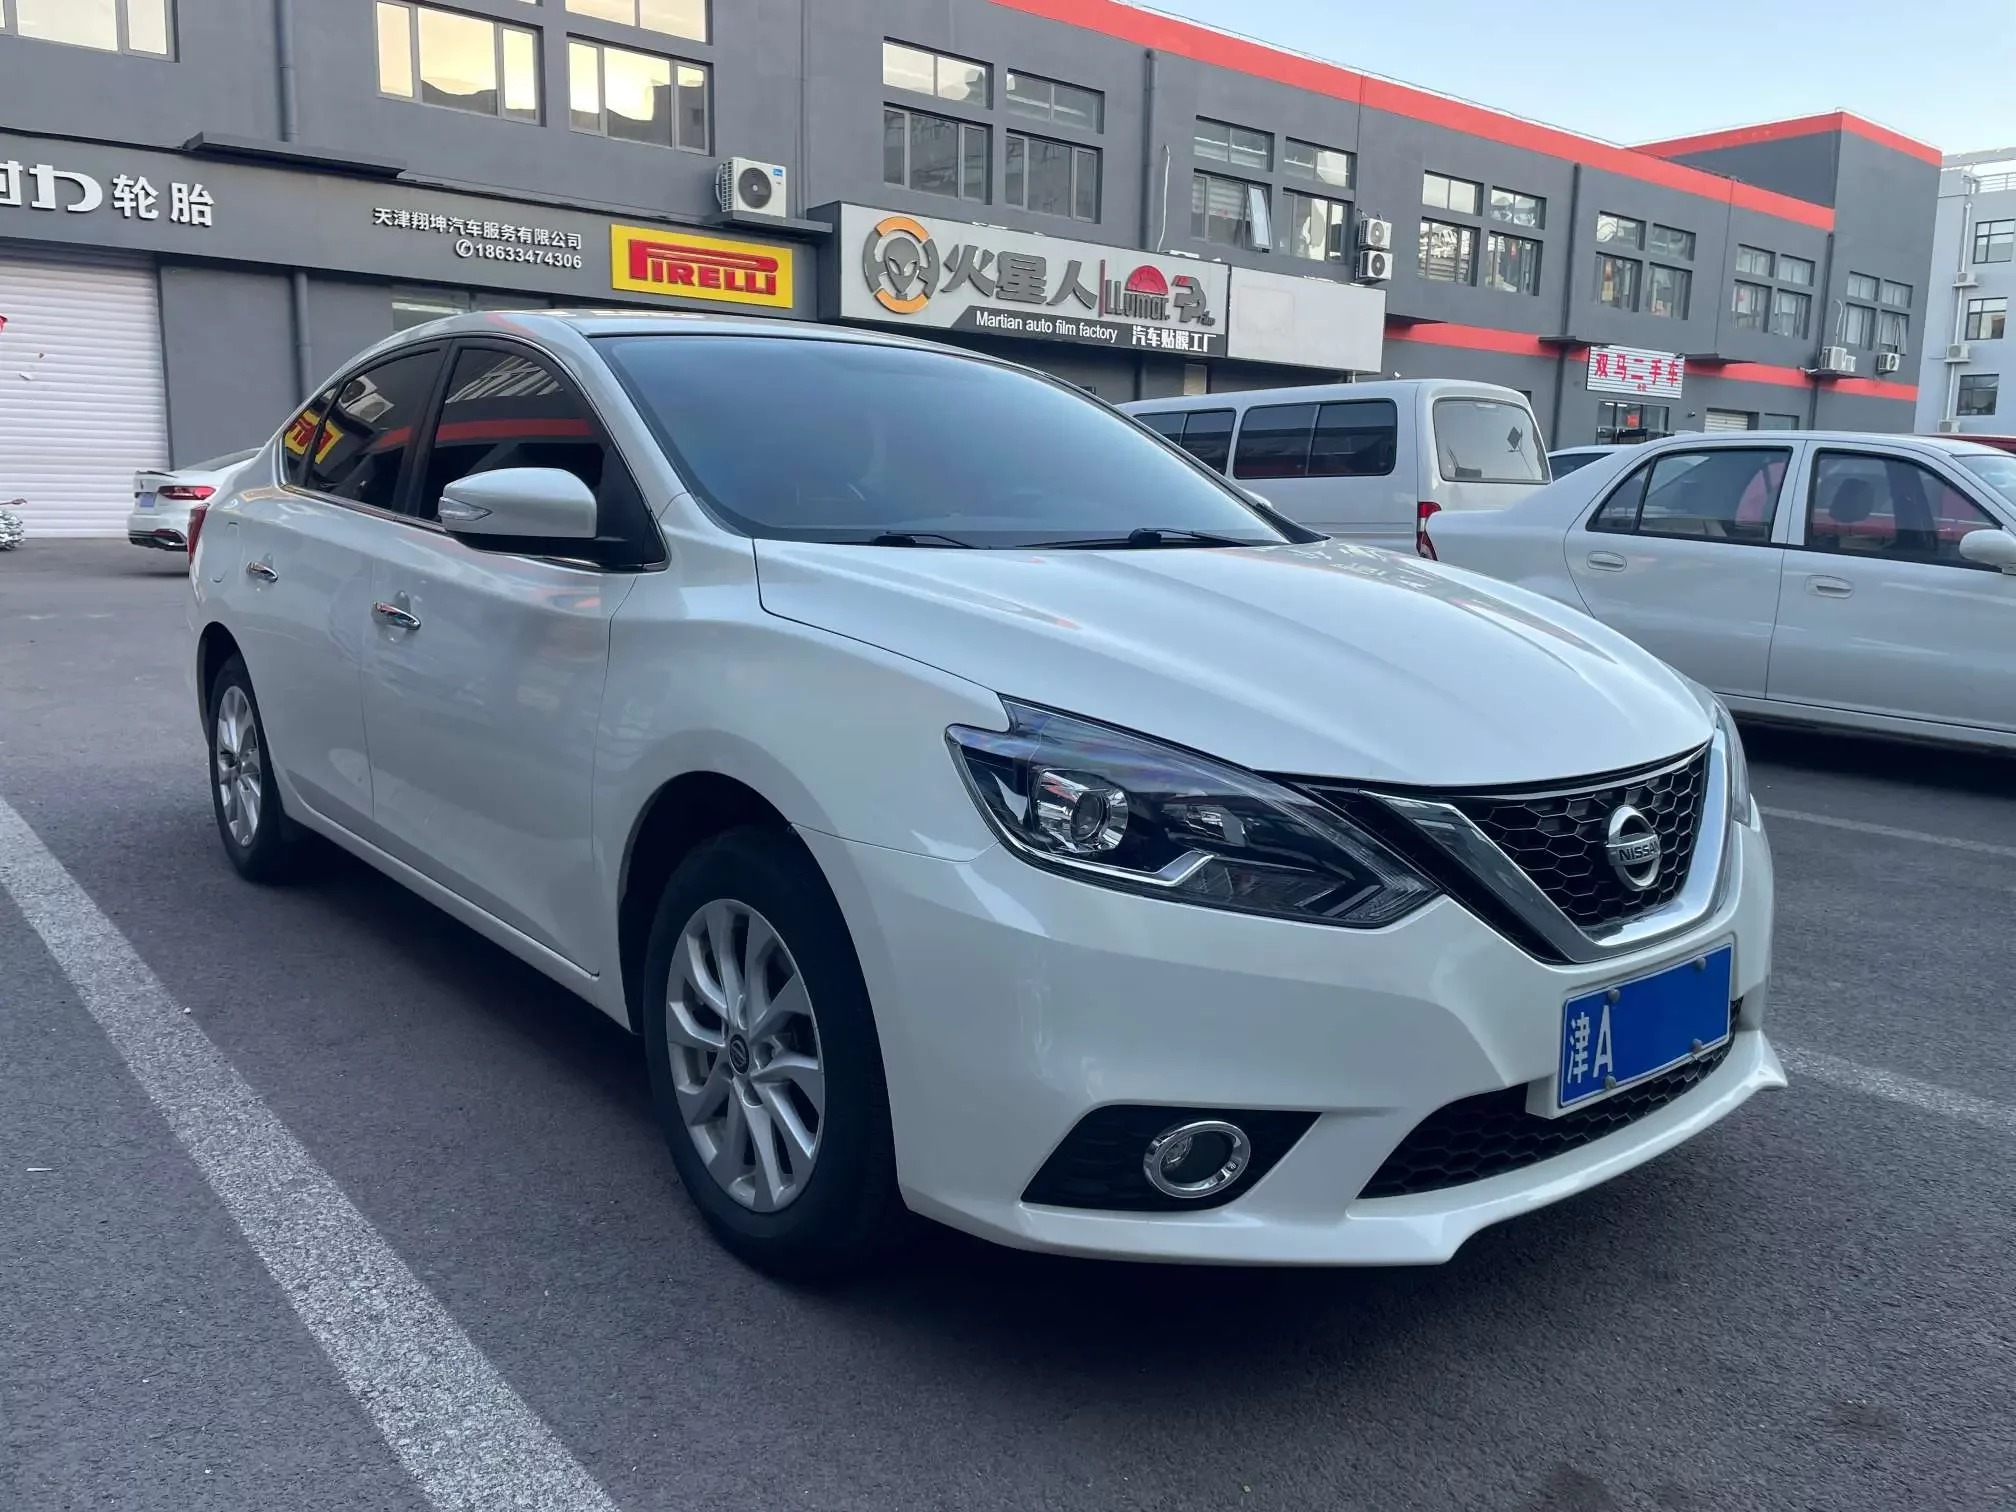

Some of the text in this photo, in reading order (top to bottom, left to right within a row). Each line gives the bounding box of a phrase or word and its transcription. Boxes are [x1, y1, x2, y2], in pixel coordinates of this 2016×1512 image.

[374, 207, 582, 249] 天津翔坤汽车服务有限公司
[475, 243, 583, 269] 18633474306
[629, 239, 779, 295] PIRELLI
[940, 244, 1098, 310] 火星人
[976, 310, 1118, 343] Martian auto film factory
[1132, 325, 1217, 353] 汽车贴膜工厂
[1567, 1004, 1614, 1084] 津A
